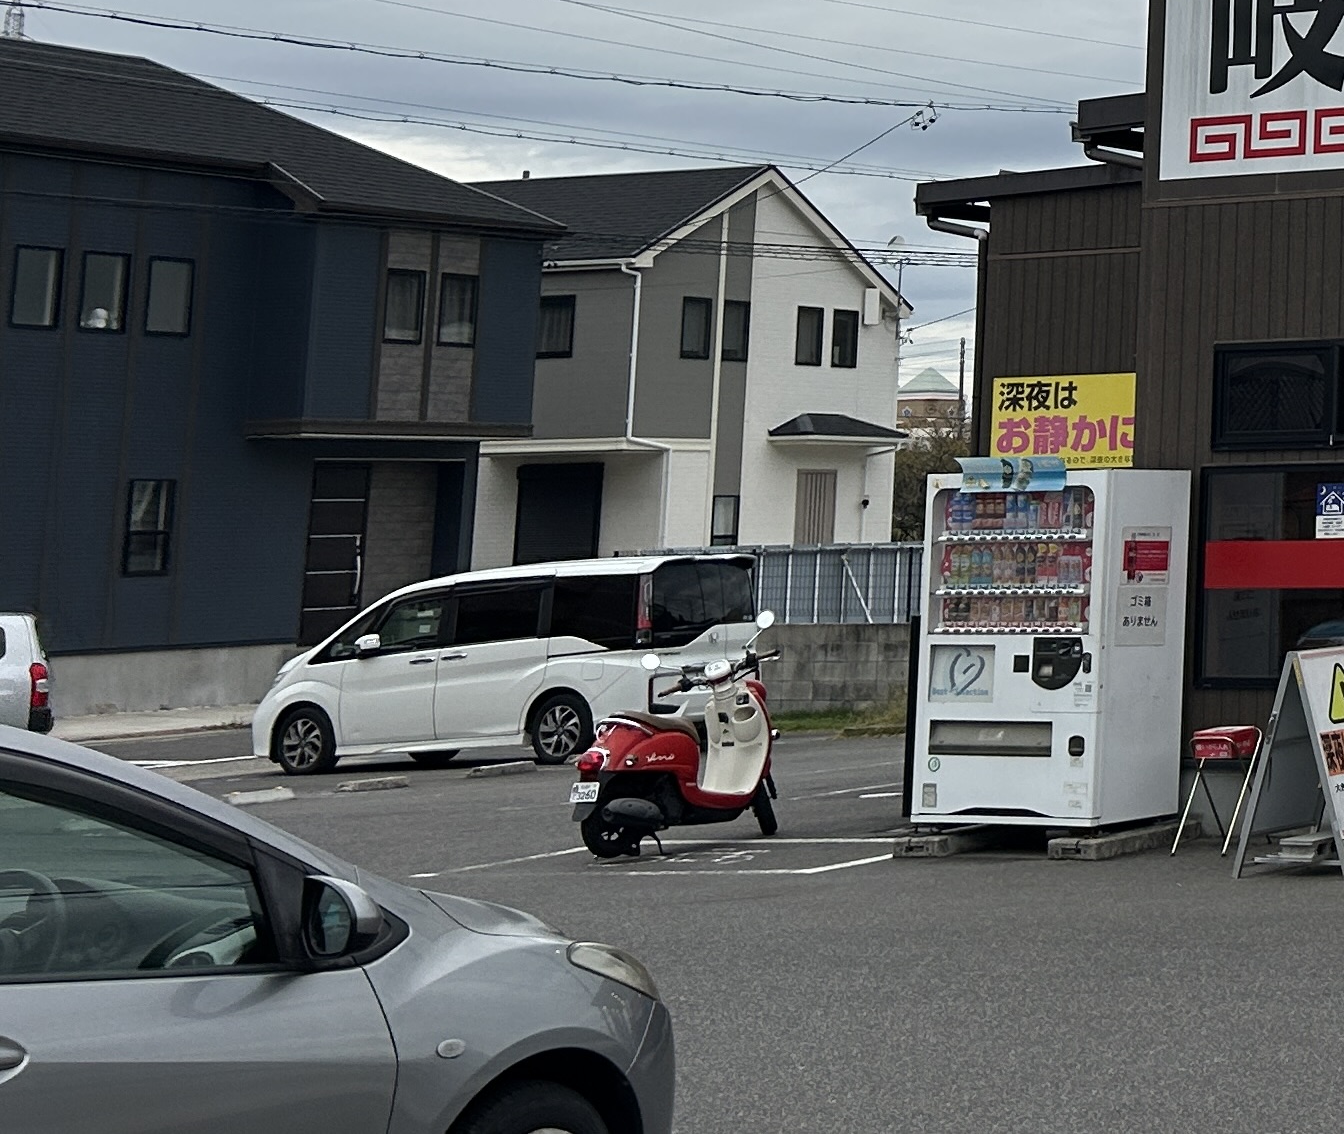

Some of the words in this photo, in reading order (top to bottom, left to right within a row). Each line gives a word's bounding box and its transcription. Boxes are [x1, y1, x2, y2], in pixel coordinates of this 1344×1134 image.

[998, 381, 1078, 412] 深夜は
[996, 415, 1135, 455] お静かに
[1130, 595, 1152, 607] ゴミ箱
[1122, 616, 1158, 627] ありません
